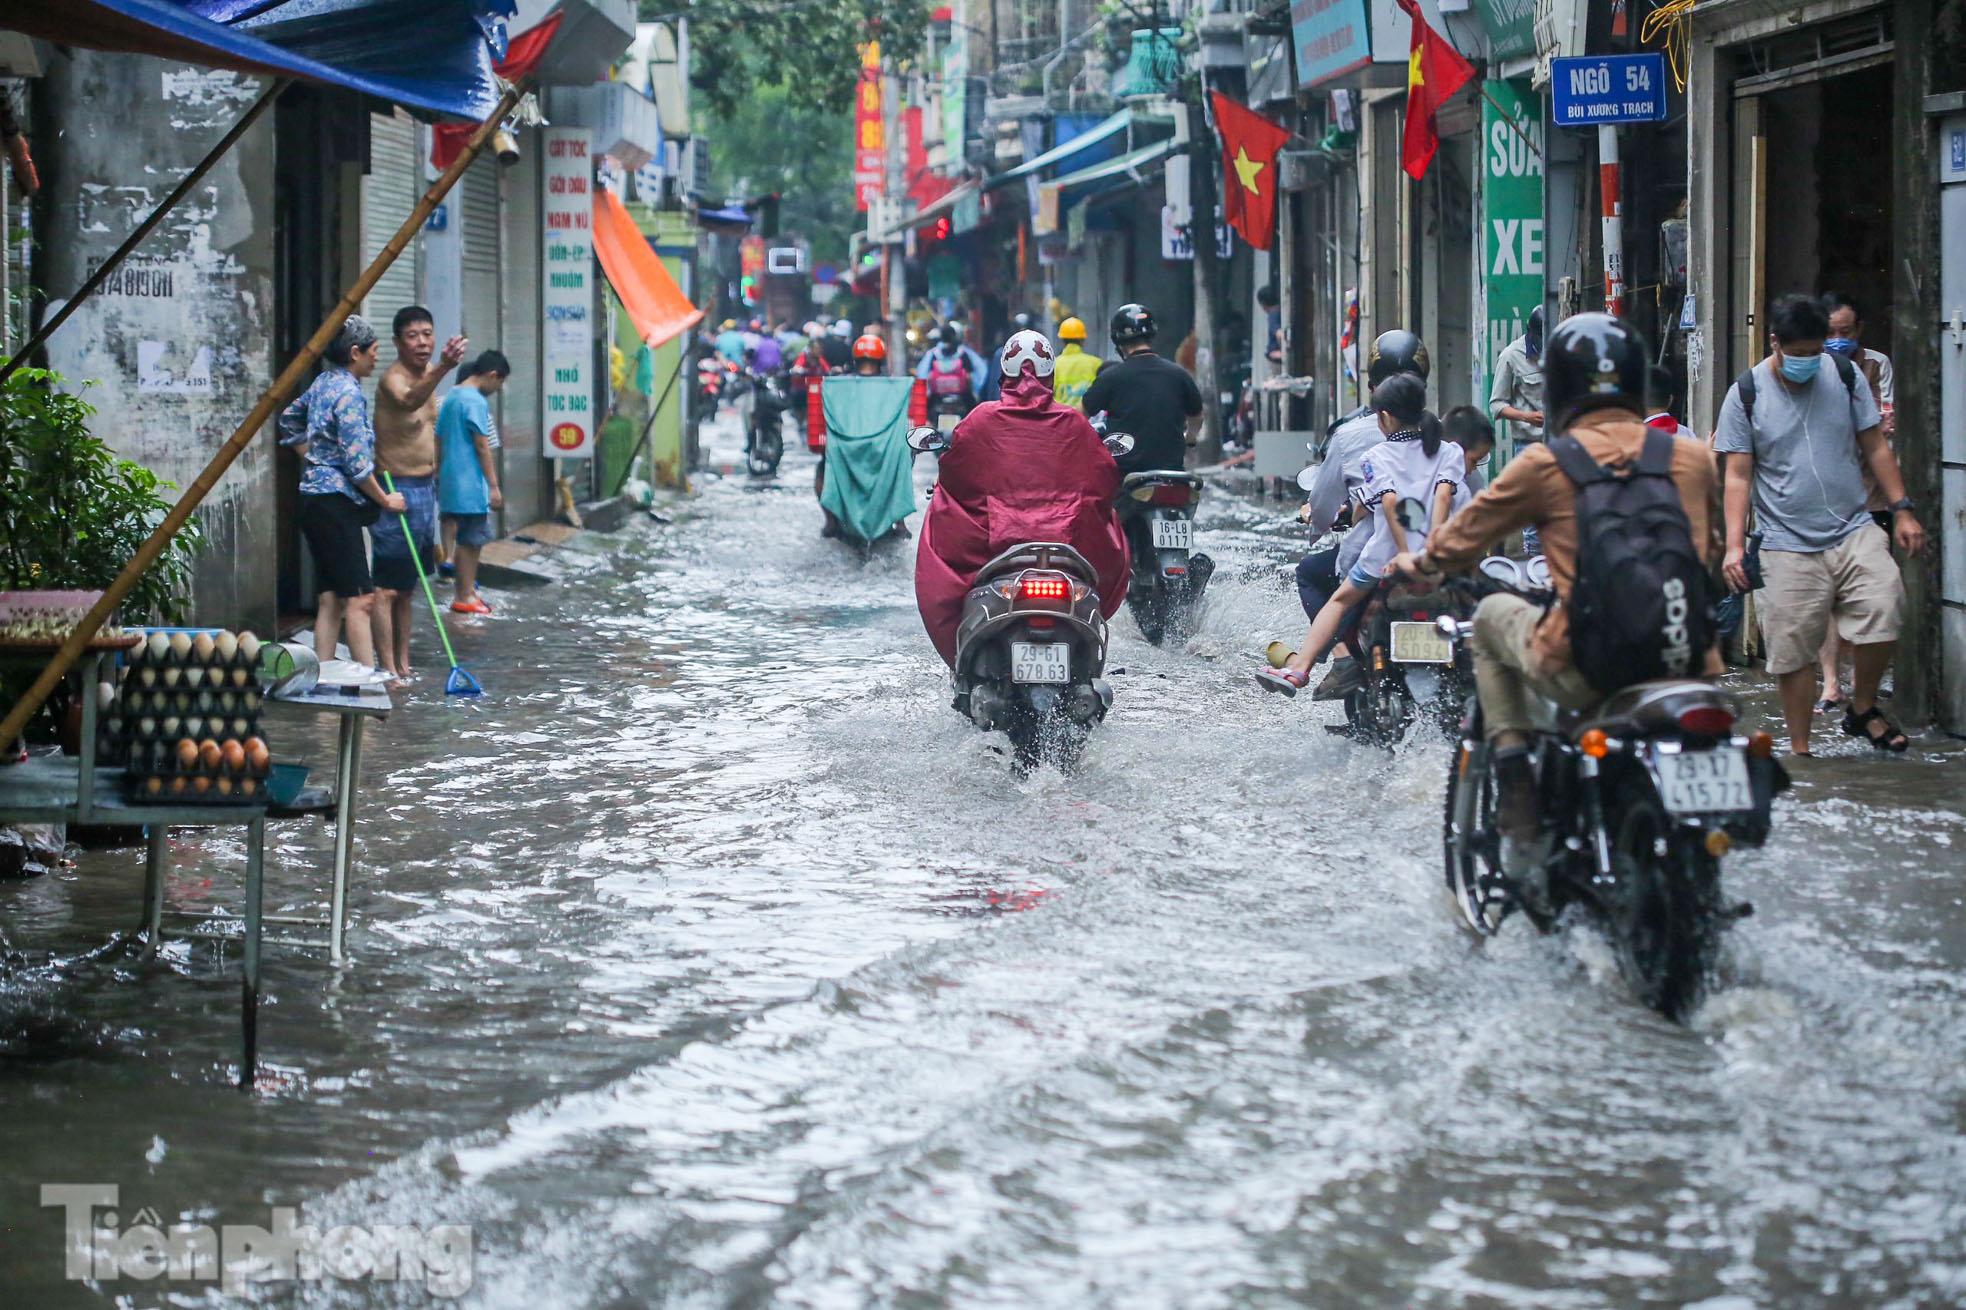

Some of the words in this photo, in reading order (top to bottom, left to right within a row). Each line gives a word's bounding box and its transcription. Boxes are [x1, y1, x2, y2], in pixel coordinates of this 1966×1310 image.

[1570, 62, 1610, 96] NGÕ
[1626, 65, 1650, 92] 54
[1567, 103, 1584, 119] BÙI
[1587, 103, 1619, 117] XƯƠNG
[1622, 101, 1654, 118] TRẠCH
[1490, 100, 1543, 178] SỬA
[547, 211, 571, 229] NAM
[1491, 218, 1543, 276] XE
[1159, 521, 1187, 535] 16-L8
[1159, 535, 1188, 547] 0117
[1021, 645, 1060, 662] 29-G1
[1016, 663, 1066, 680] 678.63
